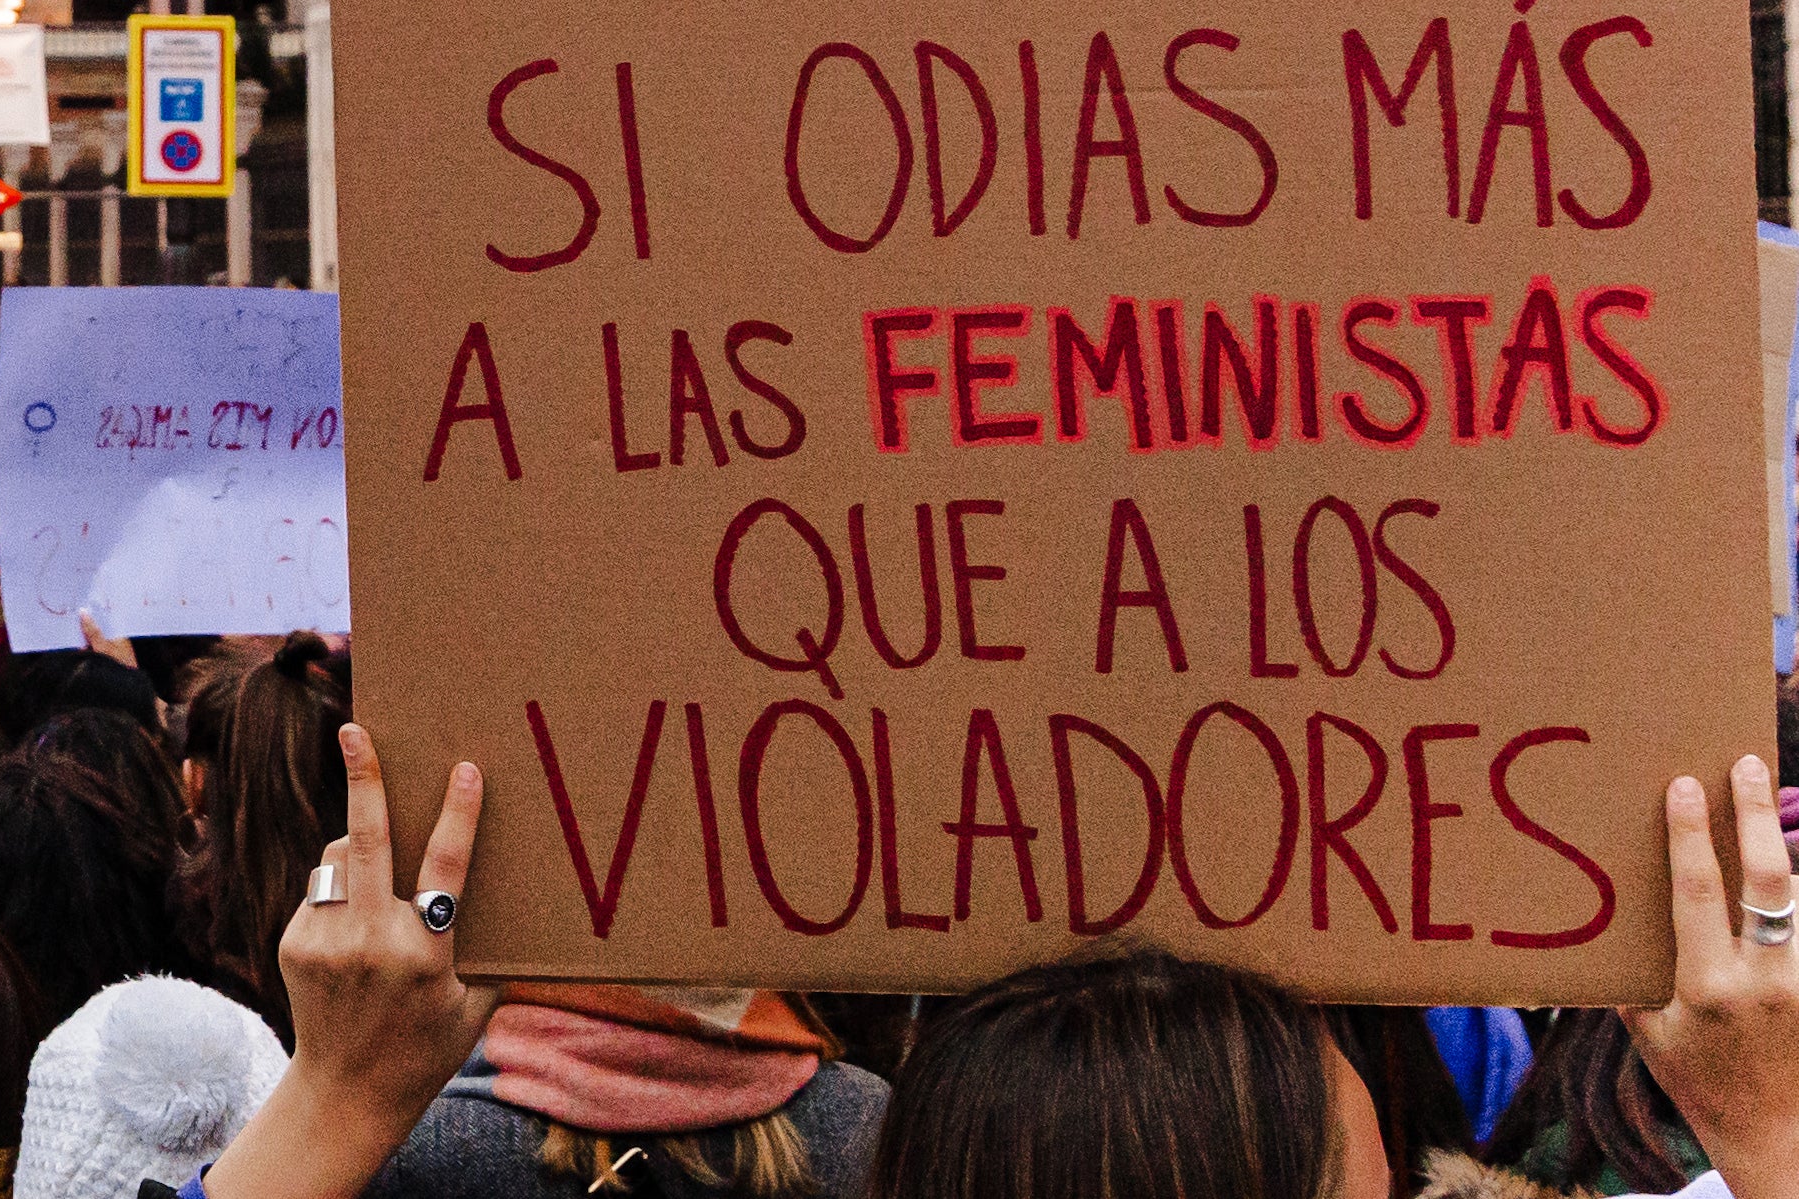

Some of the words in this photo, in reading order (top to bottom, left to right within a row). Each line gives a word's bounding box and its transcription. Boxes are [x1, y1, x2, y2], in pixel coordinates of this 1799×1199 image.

[486, 58, 650, 275] SI
[784, 27, 1277, 255] ODIAS
[423, 322, 523, 483] A
[603, 319, 808, 472] LAS
[861, 275, 1668, 456] FEMINISTAS
[712, 496, 1025, 698] QUE
[1095, 499, 1189, 675] A
[1243, 495, 1457, 682] LOS
[524, 700, 1618, 950] VIOLADORES
